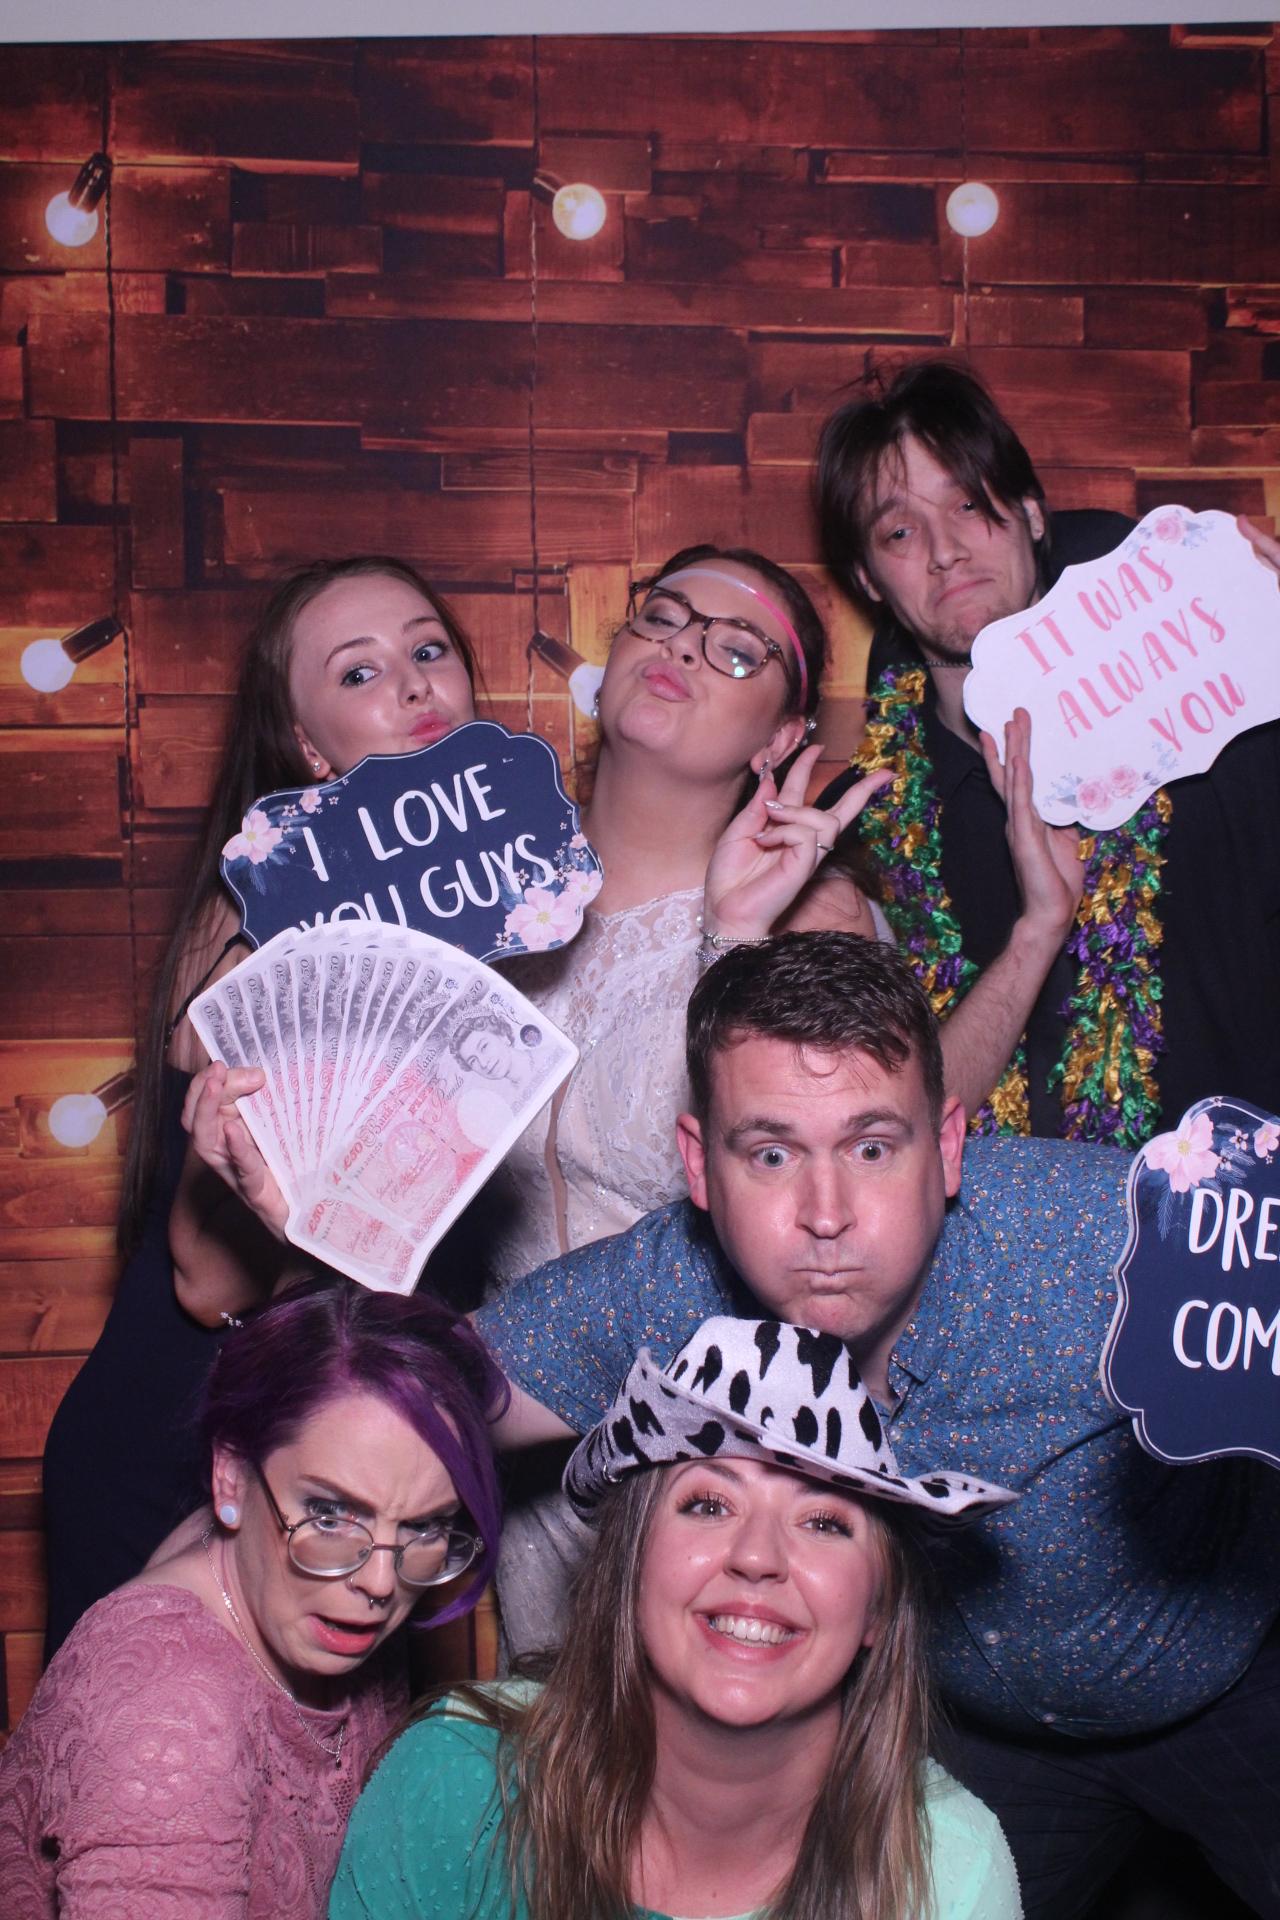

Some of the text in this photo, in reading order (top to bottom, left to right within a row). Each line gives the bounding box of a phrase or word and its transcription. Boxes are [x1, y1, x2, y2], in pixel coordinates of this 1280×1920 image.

[1015, 546, 1174, 676] IT WAS
[1057, 596, 1226, 739] ALWAYS
[1147, 673, 1246, 752] YOU
[303, 763, 506, 881] I LOVE
[420, 834, 556, 918] GUYS
[343, 1141, 363, 1171] £50
[308, 1203, 325, 1236] £50
[1189, 1188, 1280, 1272] DRE
[1173, 1300, 1280, 1375] COM
